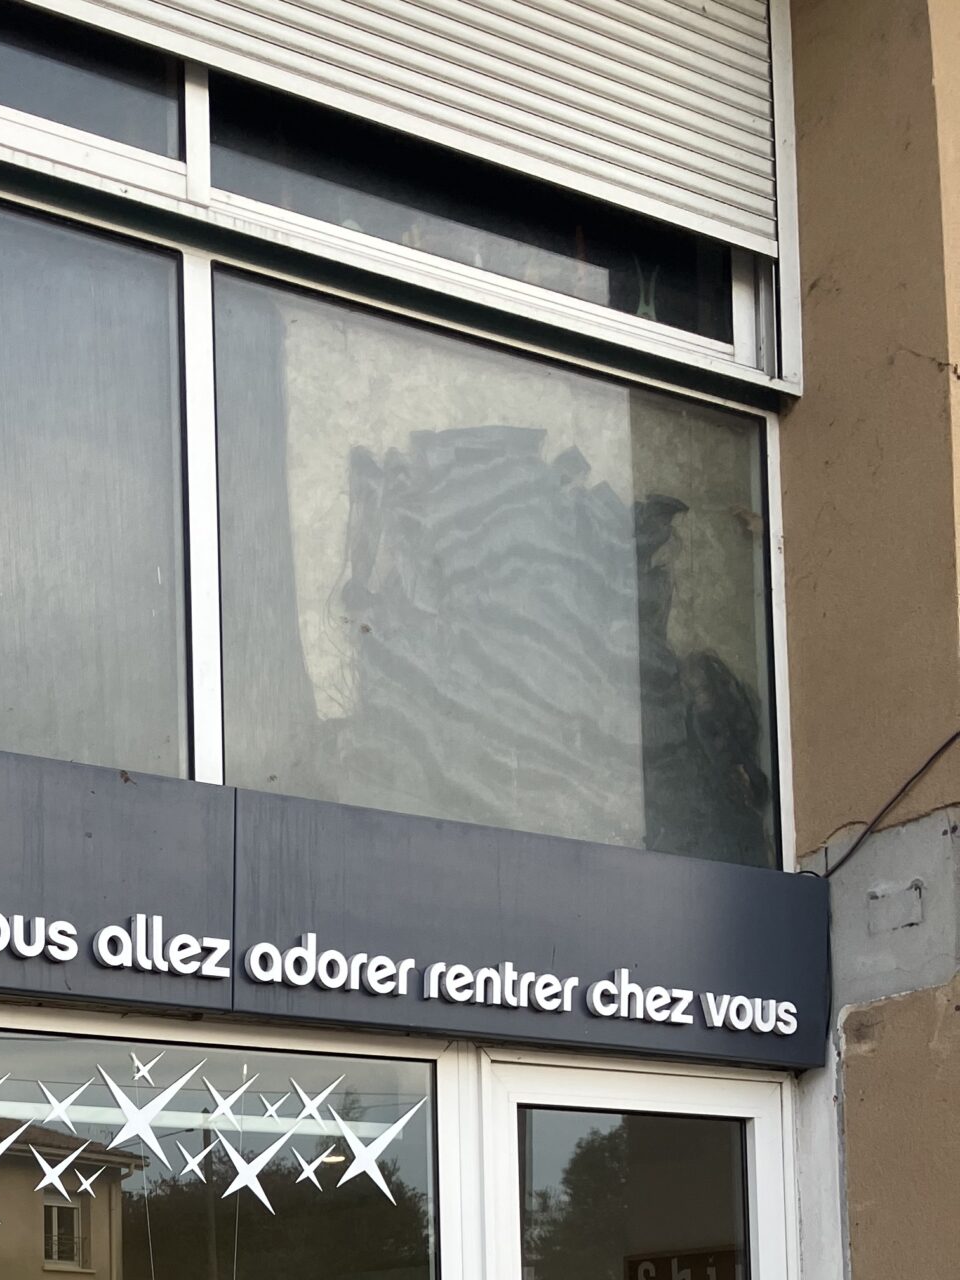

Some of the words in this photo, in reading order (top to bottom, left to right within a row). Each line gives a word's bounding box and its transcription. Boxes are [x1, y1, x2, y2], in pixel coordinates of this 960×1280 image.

[93, 913, 230, 979] allez
[245, 932, 418, 998] adorer
[423, 960, 579, 1013] rentrer
[587, 968, 694, 1026] chez
[699, 992, 798, 1036] vous
